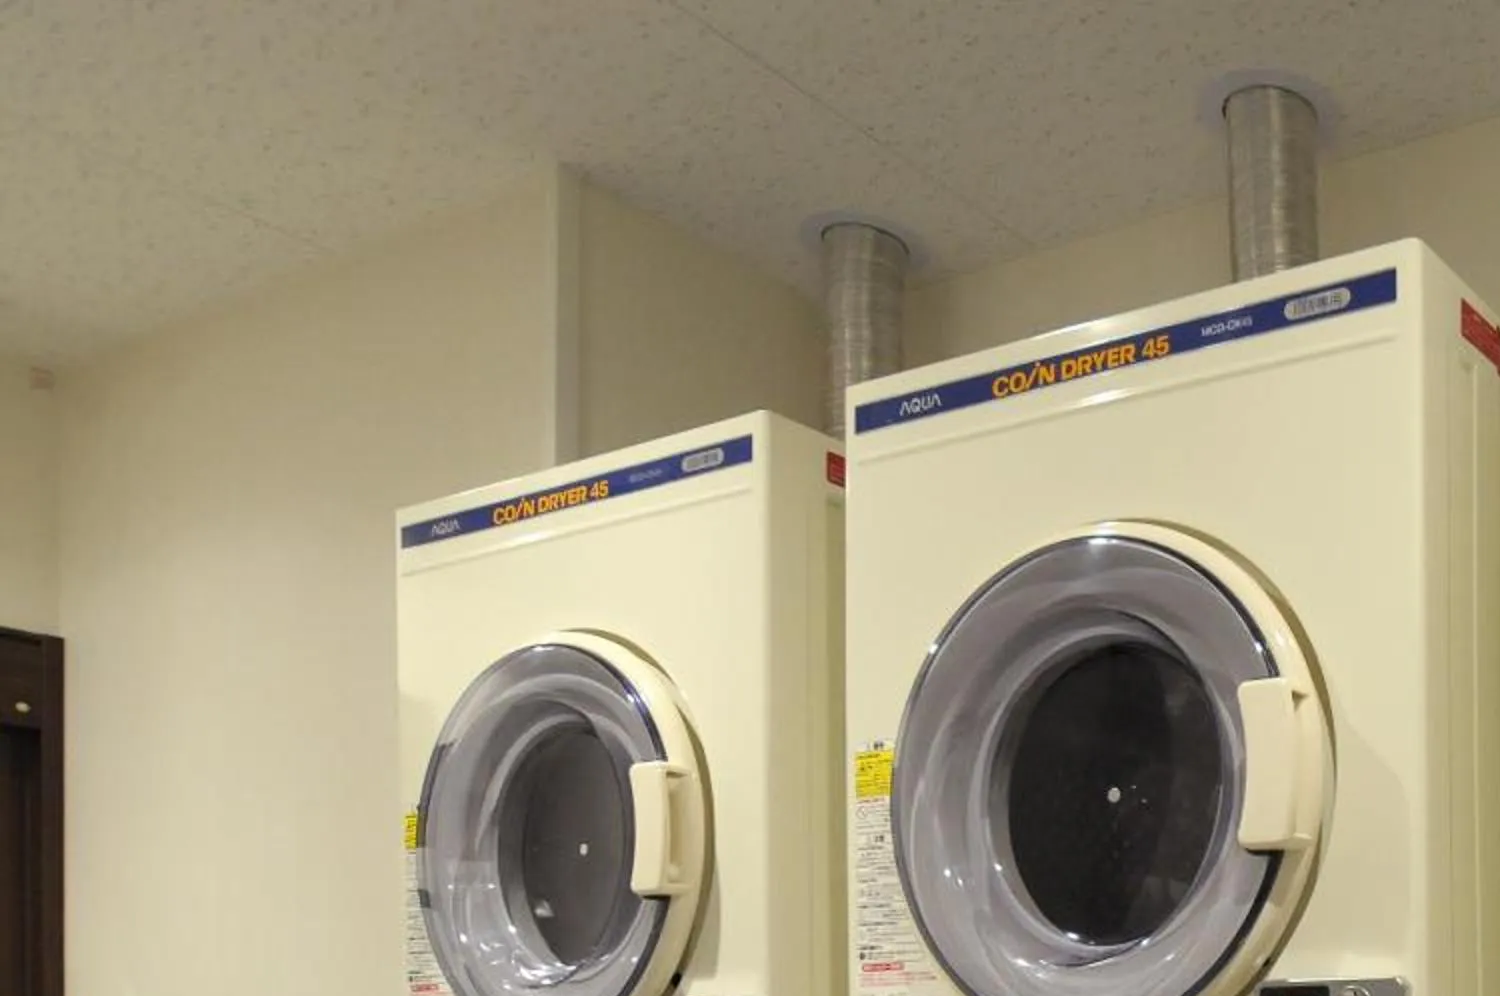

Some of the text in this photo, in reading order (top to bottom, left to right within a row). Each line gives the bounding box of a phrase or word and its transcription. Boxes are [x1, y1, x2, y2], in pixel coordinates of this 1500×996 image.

[1061, 344, 1136, 379] DRYER
[1142, 335, 1169, 357] 45
[899, 394, 941, 416] AQUA
[538, 484, 588, 513] DRYER
[589, 480, 609, 498] 45
